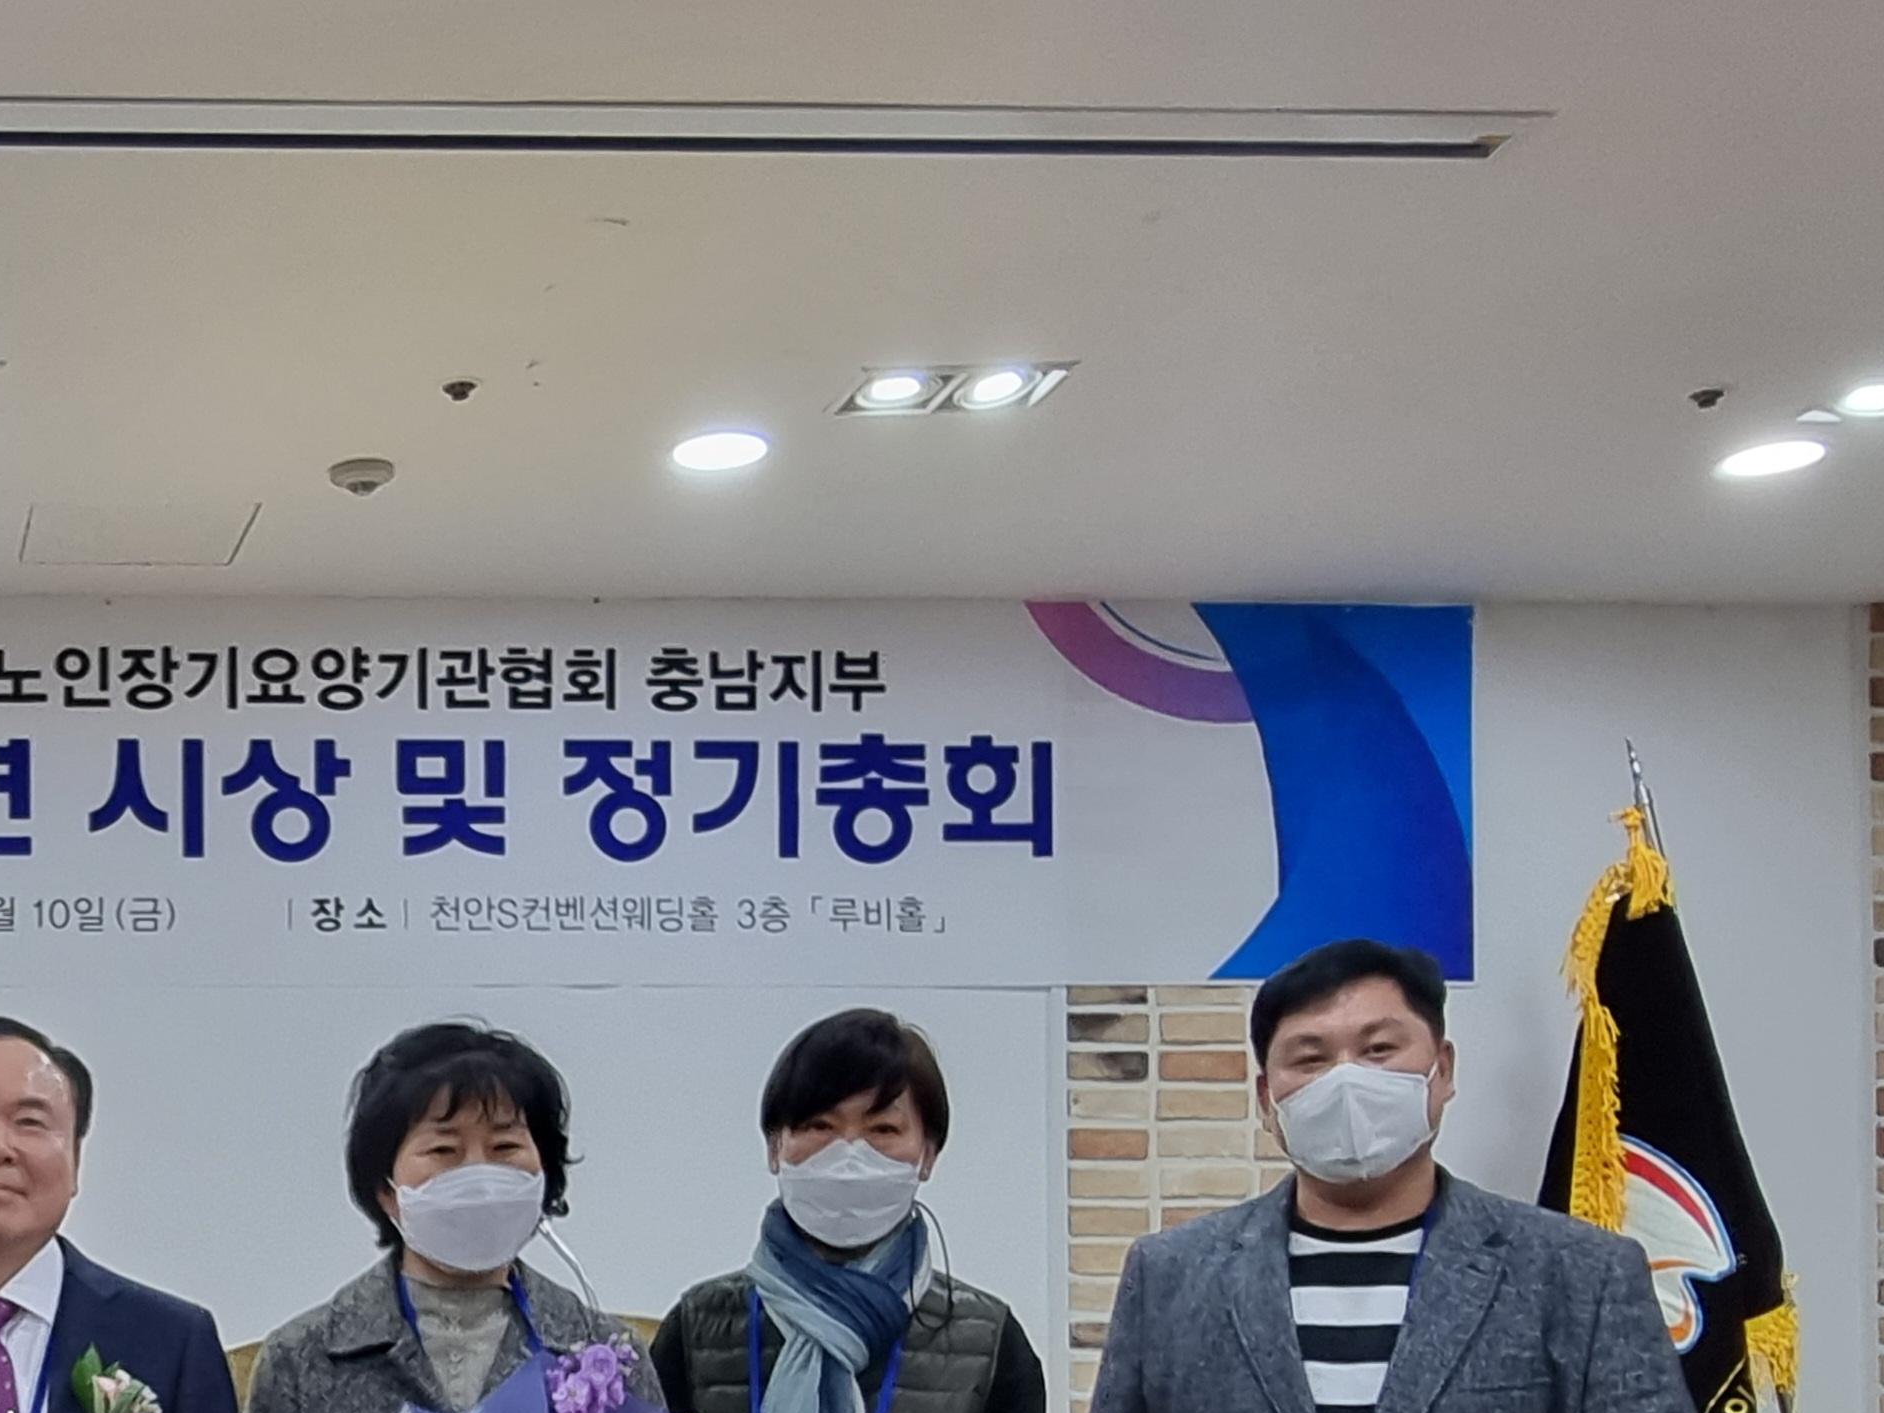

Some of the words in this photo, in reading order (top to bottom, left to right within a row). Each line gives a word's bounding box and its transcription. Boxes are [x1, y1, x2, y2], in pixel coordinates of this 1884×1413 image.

[645, 647, 887, 713] 충남지부
[88, 737, 352, 863] 시상
[395, 738, 506, 857] 및
[562, 732, 1054, 865] 정기총회
[430, 895, 719, 933] 천안S컨벤션웨딩홀
[737, 895, 791, 934] 3층
